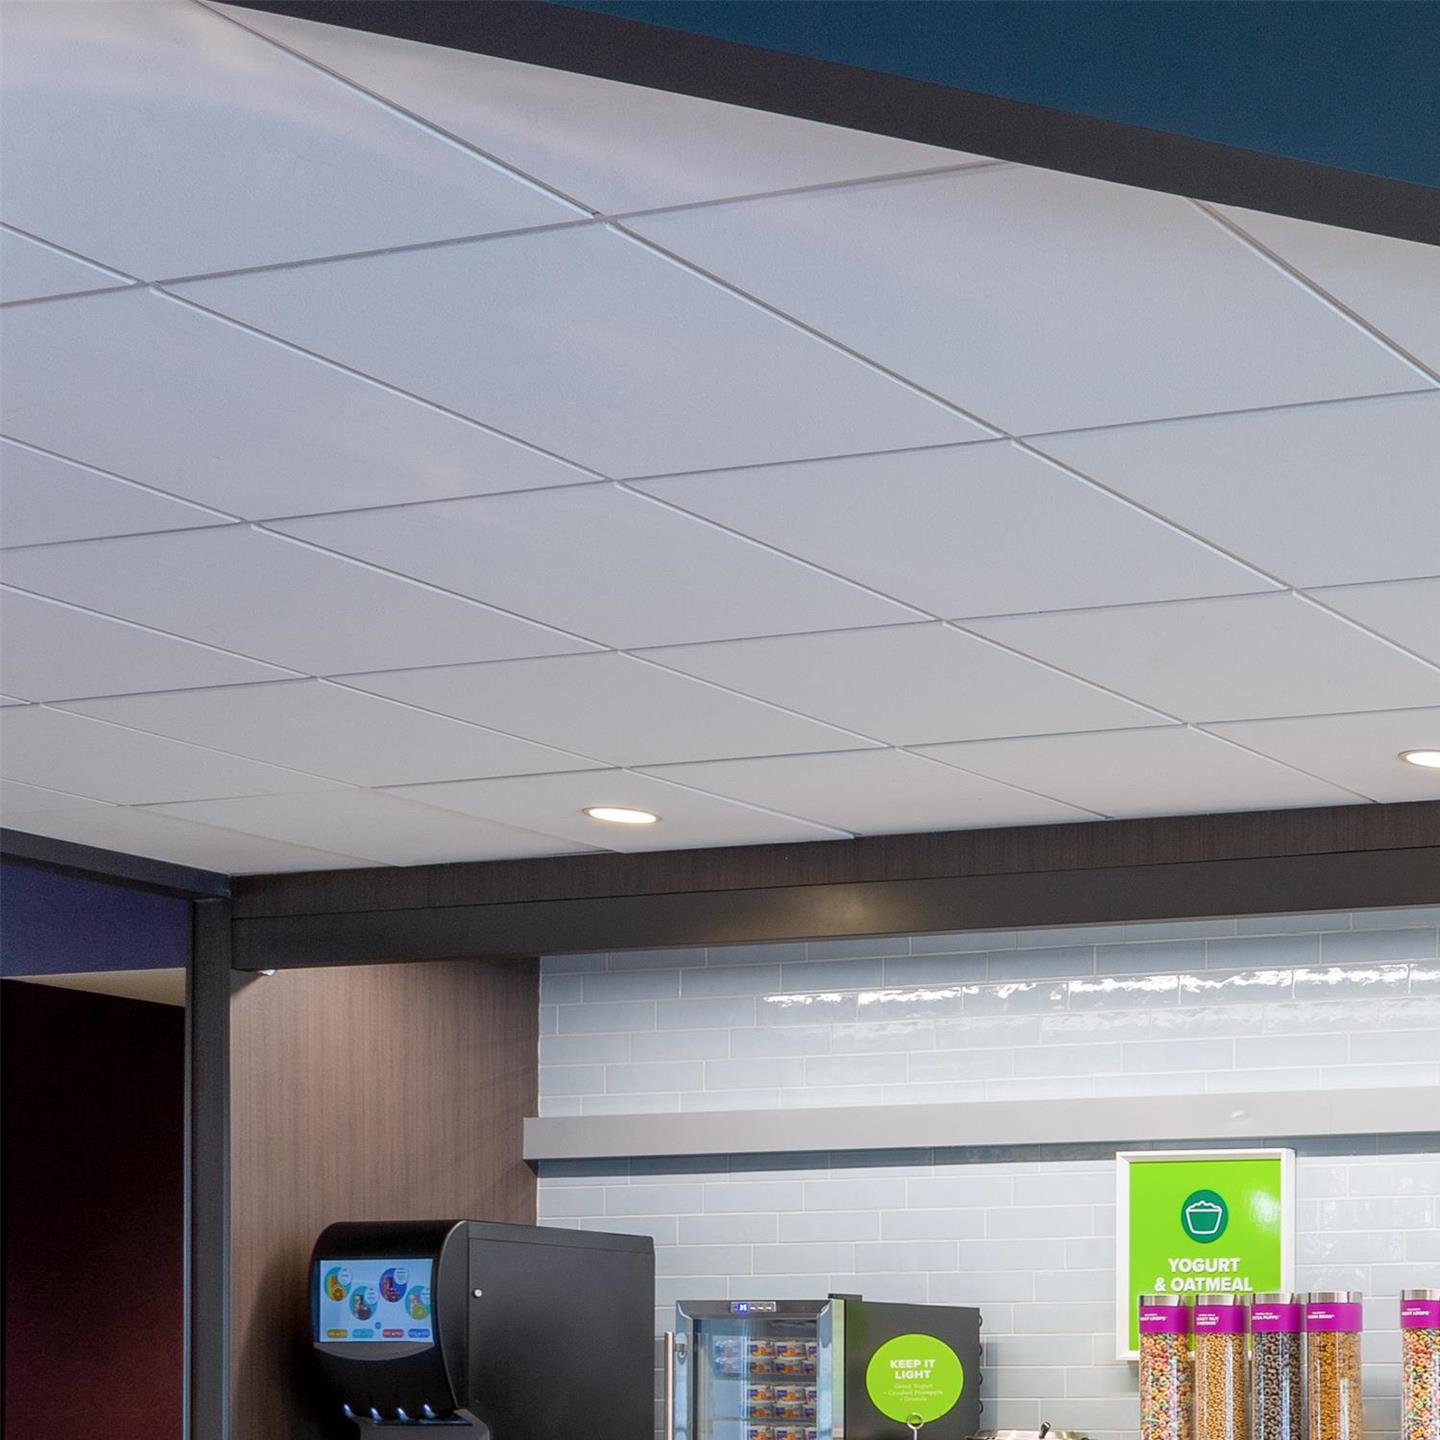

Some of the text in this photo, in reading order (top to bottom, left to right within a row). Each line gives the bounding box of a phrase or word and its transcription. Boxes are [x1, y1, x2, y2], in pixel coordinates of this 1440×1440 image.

[1167, 1257, 1241, 1273] YOGURT
[1154, 1276, 1254, 1292] & OATMEAL
[889, 1359, 936, 1369] KEEP IT
[895, 1369, 931, 1379] LIGHT
